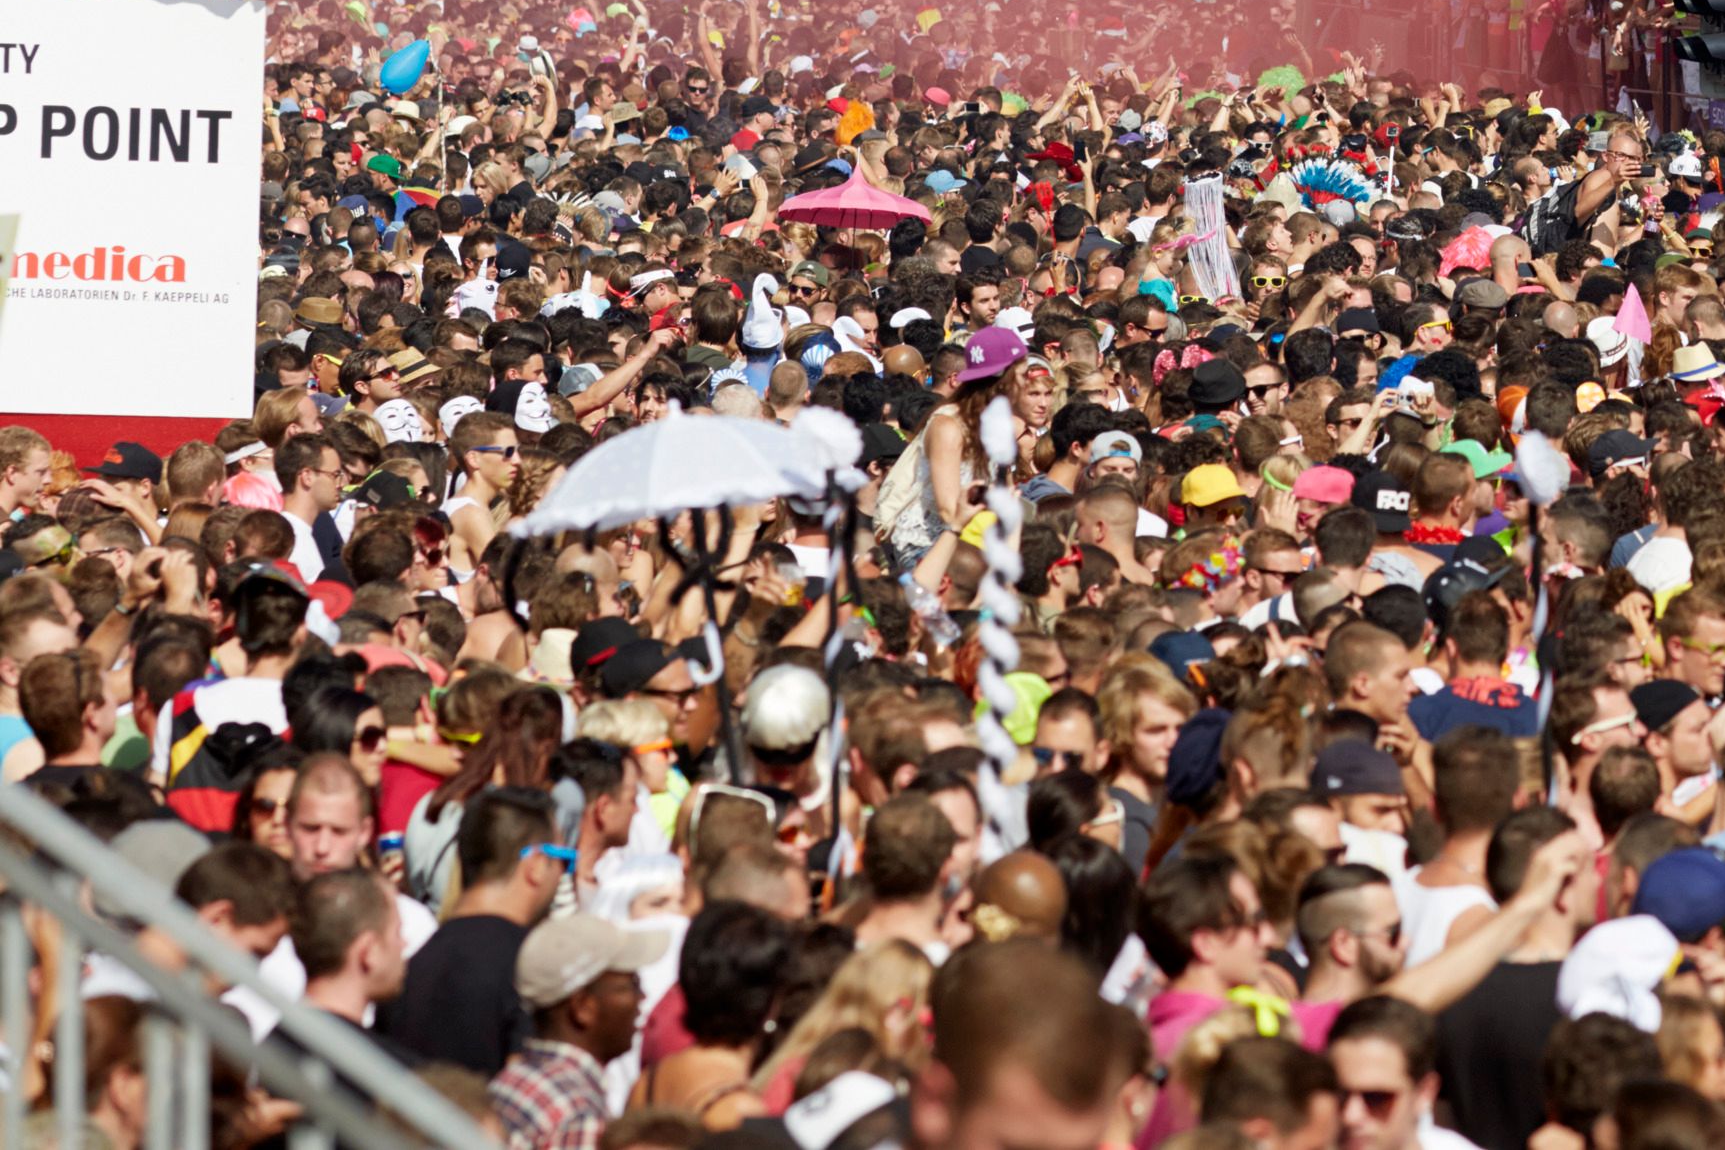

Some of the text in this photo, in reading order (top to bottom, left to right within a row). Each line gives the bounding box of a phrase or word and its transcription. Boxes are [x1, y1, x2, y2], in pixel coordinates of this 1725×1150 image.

[40, 104, 233, 164] POINT
[31, 288, 119, 300] LABORATORIEN
[154, 291, 209, 303] KAEPPELI
[213, 293, 229, 304] AG
